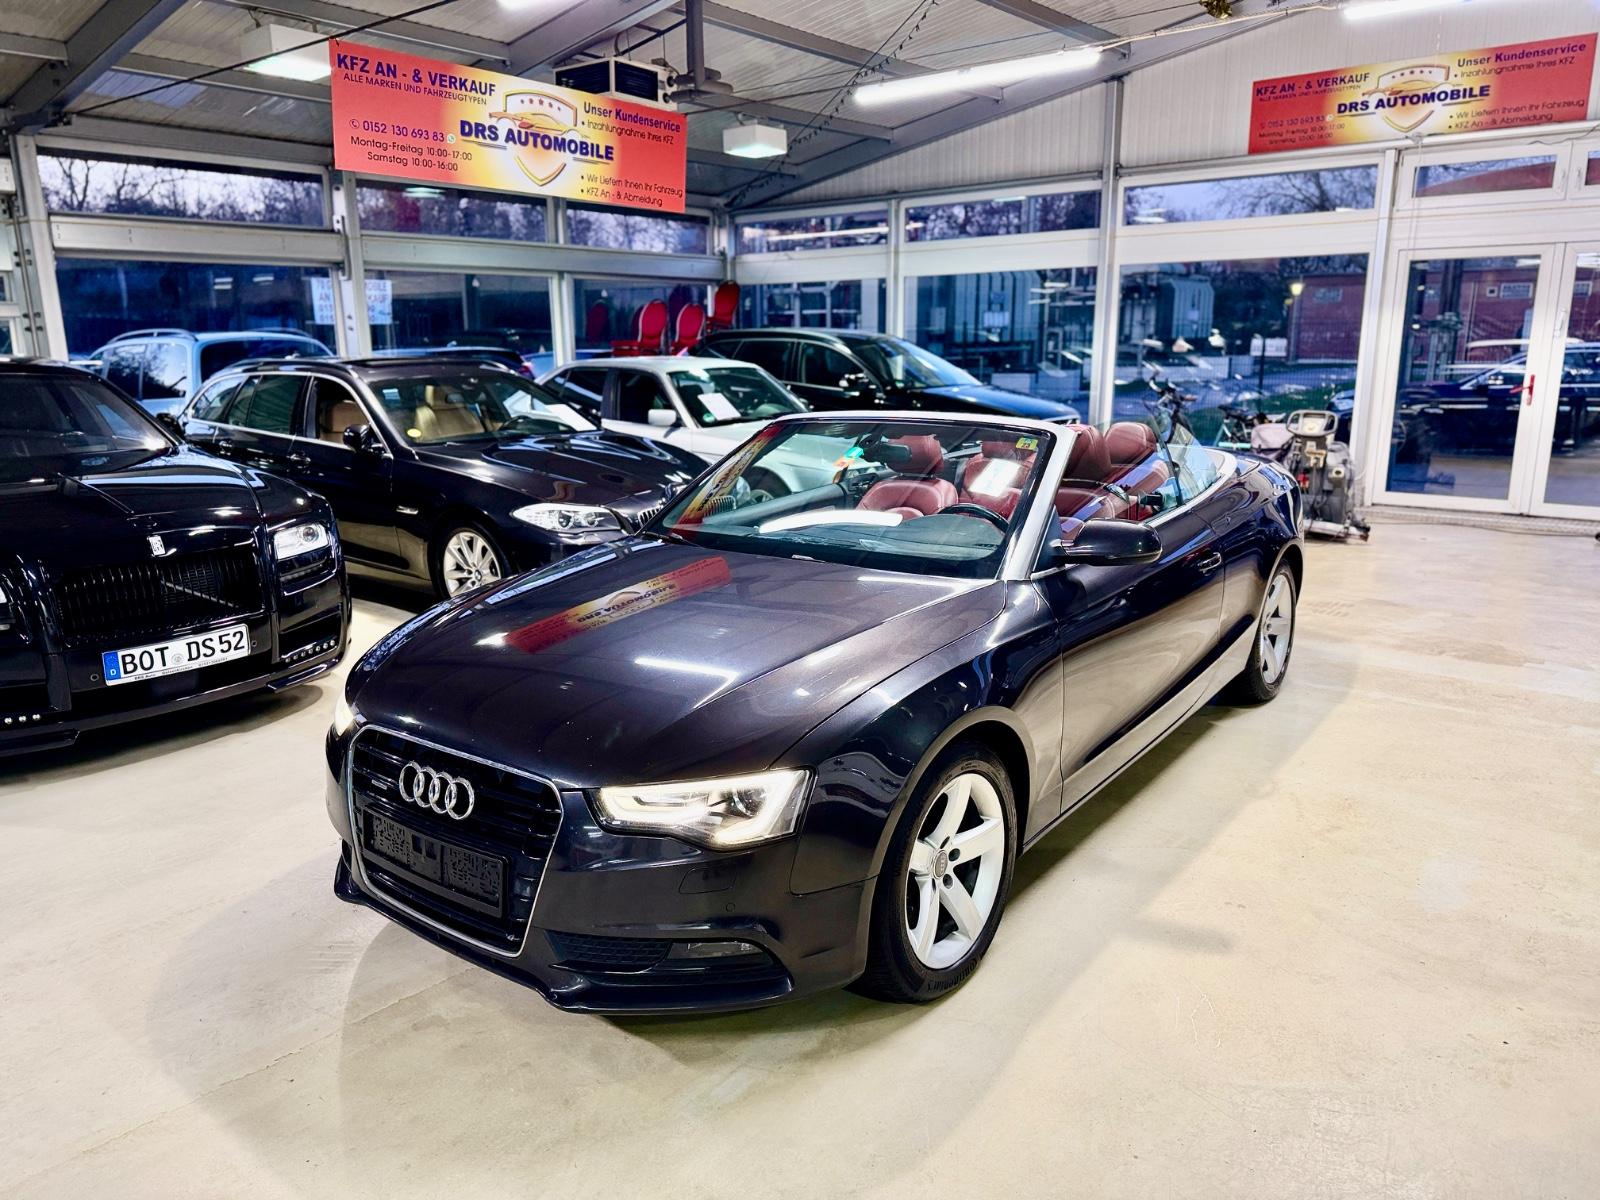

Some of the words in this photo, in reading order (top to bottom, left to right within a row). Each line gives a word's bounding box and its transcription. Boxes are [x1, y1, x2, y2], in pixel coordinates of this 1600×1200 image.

[1457, 56, 1492, 68] Unser
[1494, 42, 1587, 63] Kundenservice
[1558, 56, 1576, 65] KFZ
[337, 53, 370, 74] KFZ
[375, 61, 397, 79] AN
[412, 68, 423, 83] &
[428, 71, 496, 96] VERKAUF
[1256, 85, 1277, 97] KFZ
[1279, 83, 1296, 93] AN
[1304, 80, 1313, 90] &
[1316, 73, 1370, 88] VERKAUF
[343, 73, 364, 83] ALLE
[365, 76, 402, 89] MARKEN
[403, 83, 421, 94] UND
[423, 87, 487, 105] FAHRZEUGTYPEN
[1337, 100, 1370, 114] DRS
[1374, 84, 1491, 110] AUTOMOBILE
[1541, 99, 1585, 110] Fahrzeug
[583, 101, 612, 118] Unser
[615, 107, 681, 133] Kundenservice
[363, 120, 387, 134] 0152
[391, 124, 408, 137] 130
[411, 128, 429, 140] 693
[432, 131, 445, 143] 83
[460, 119, 500, 141] DRS
[504, 128, 615, 161] AUTOMOBILE
[662, 135, 674, 145] KFZ
[350, 136, 424, 156] Montag-Freitag
[367, 151, 408, 167] Samstag
[586, 187, 599, 197] KFZ
[600, 189, 611, 198] An
[623, 192, 663, 207] Abmeldung
[653, 184, 683, 198] Fahrzeug
[121, 646, 169, 675] BOT
